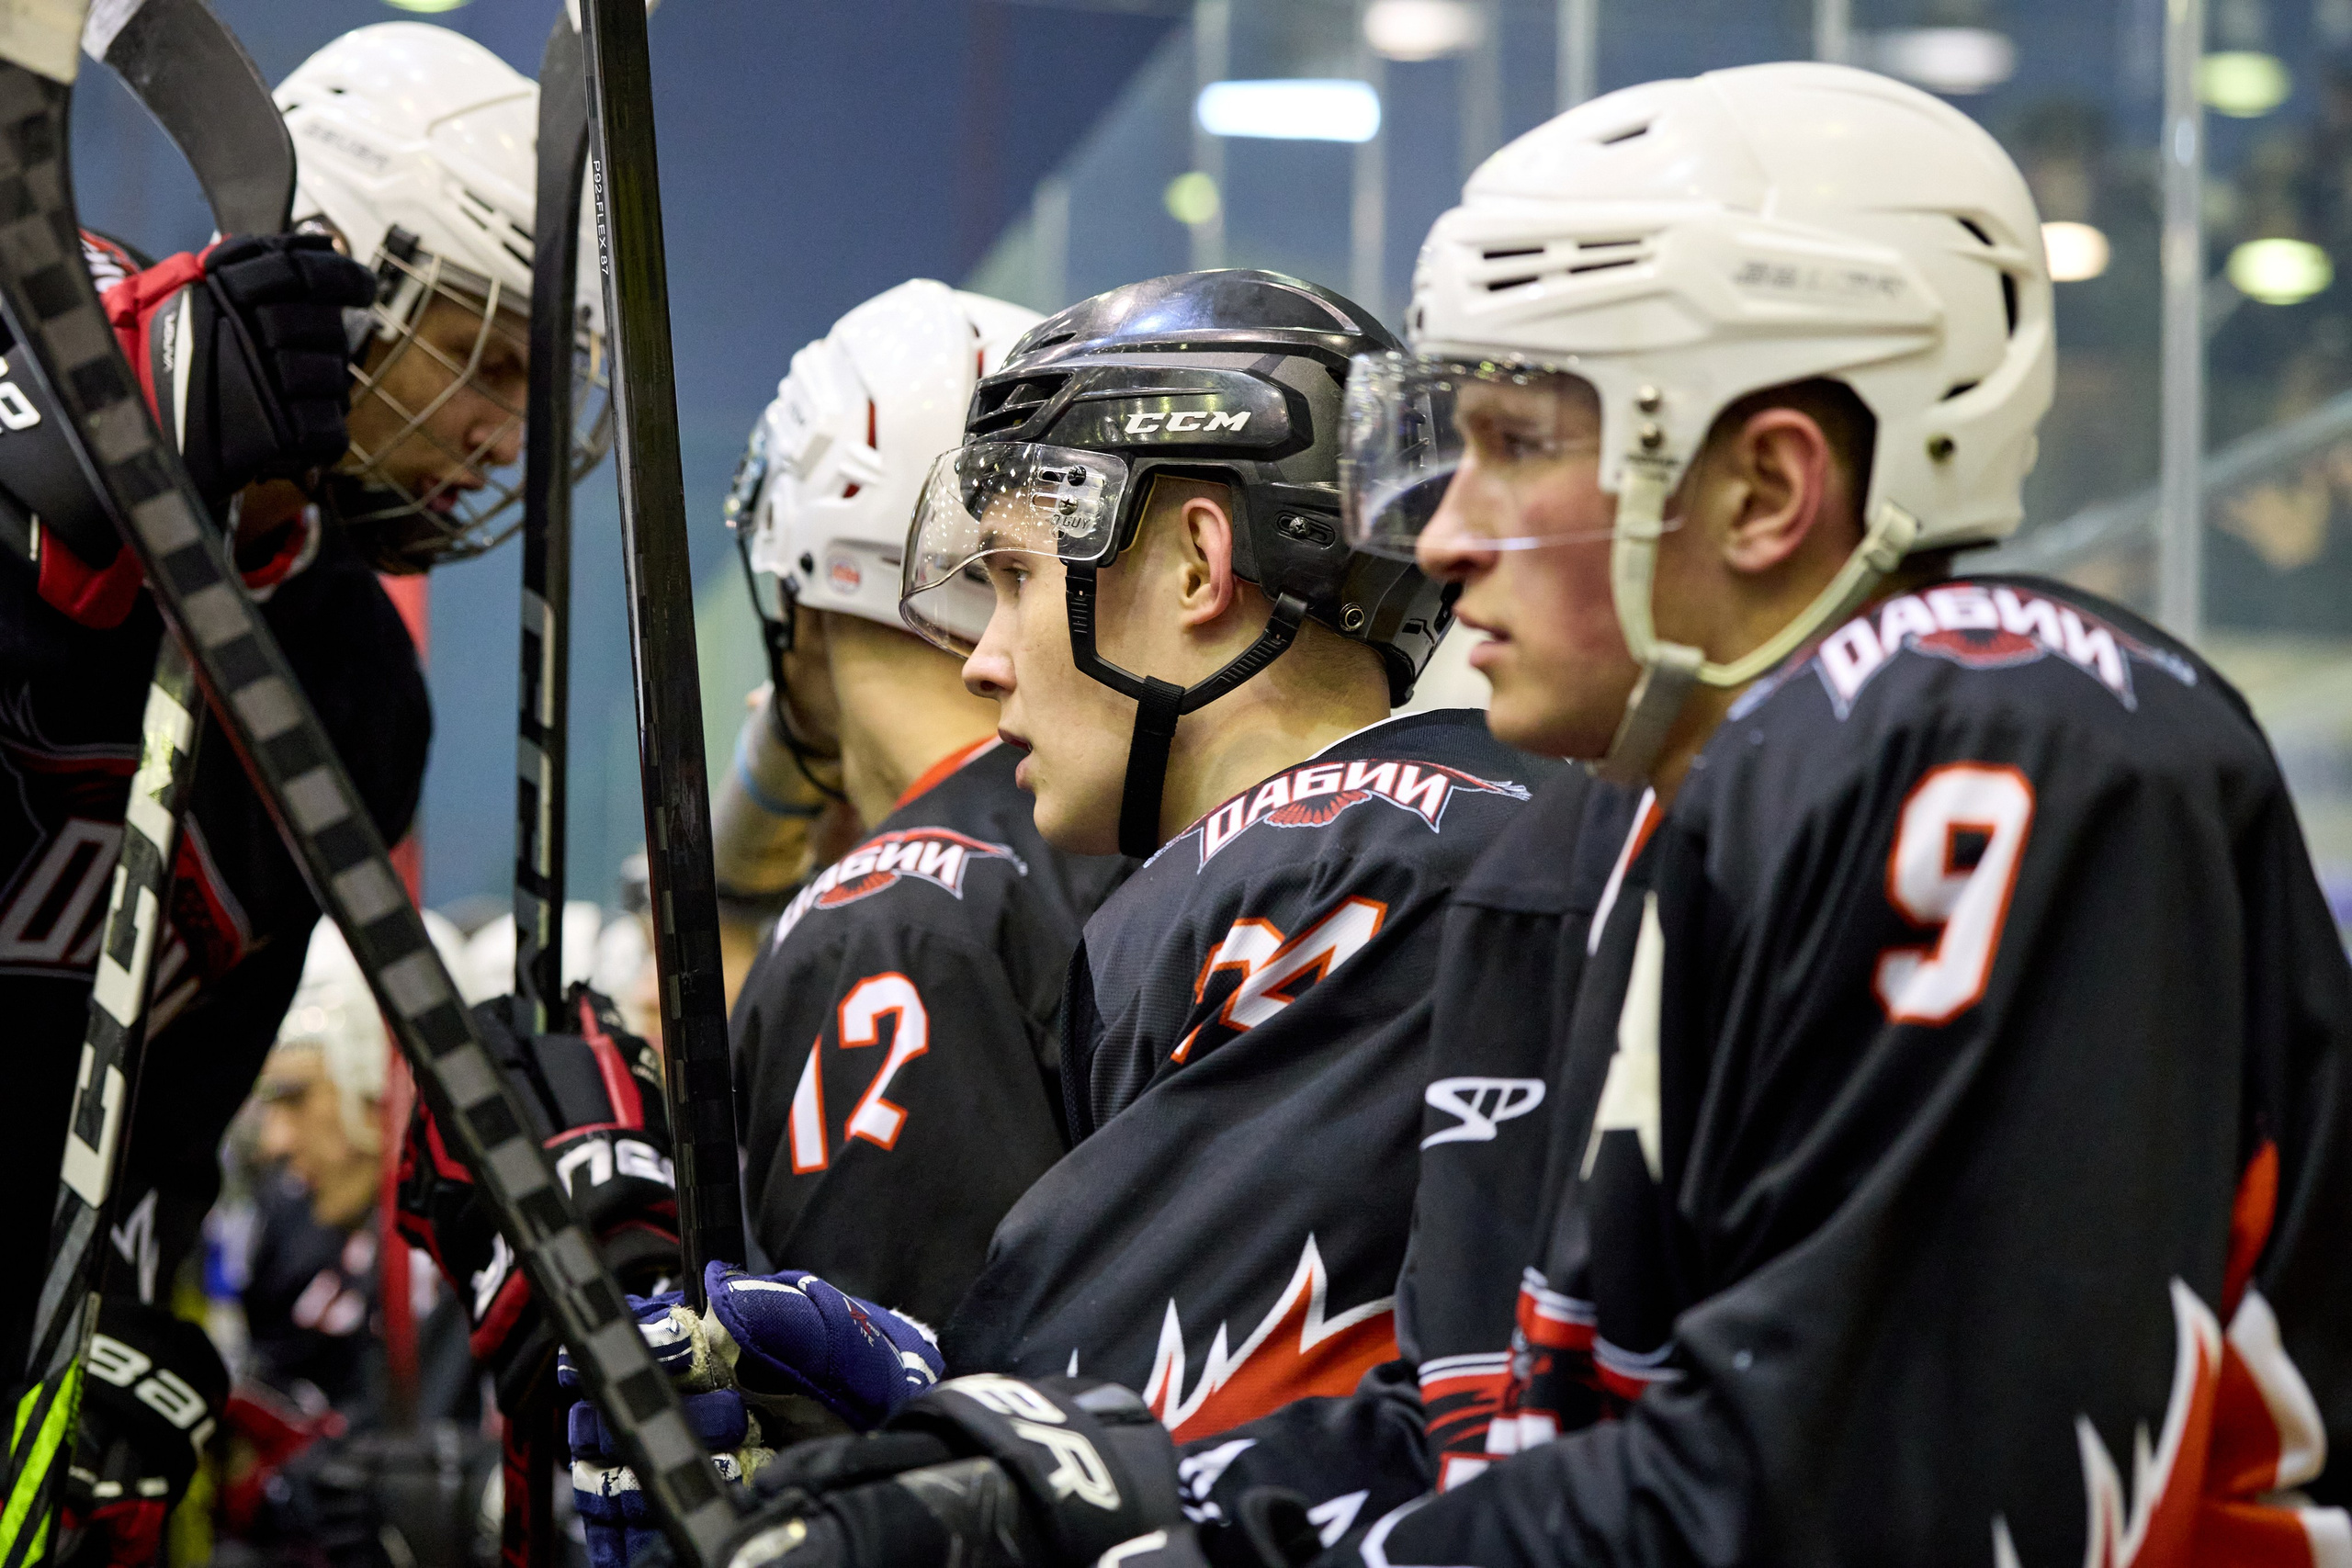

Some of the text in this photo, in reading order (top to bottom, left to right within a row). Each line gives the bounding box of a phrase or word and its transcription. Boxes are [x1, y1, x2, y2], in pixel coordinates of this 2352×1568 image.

[593, 160, 609, 276] P92-FLEX 87
[1125, 412, 1251, 434] CCM
[1870, 760, 2037, 1029] 9
[788, 970, 930, 1176] 12
